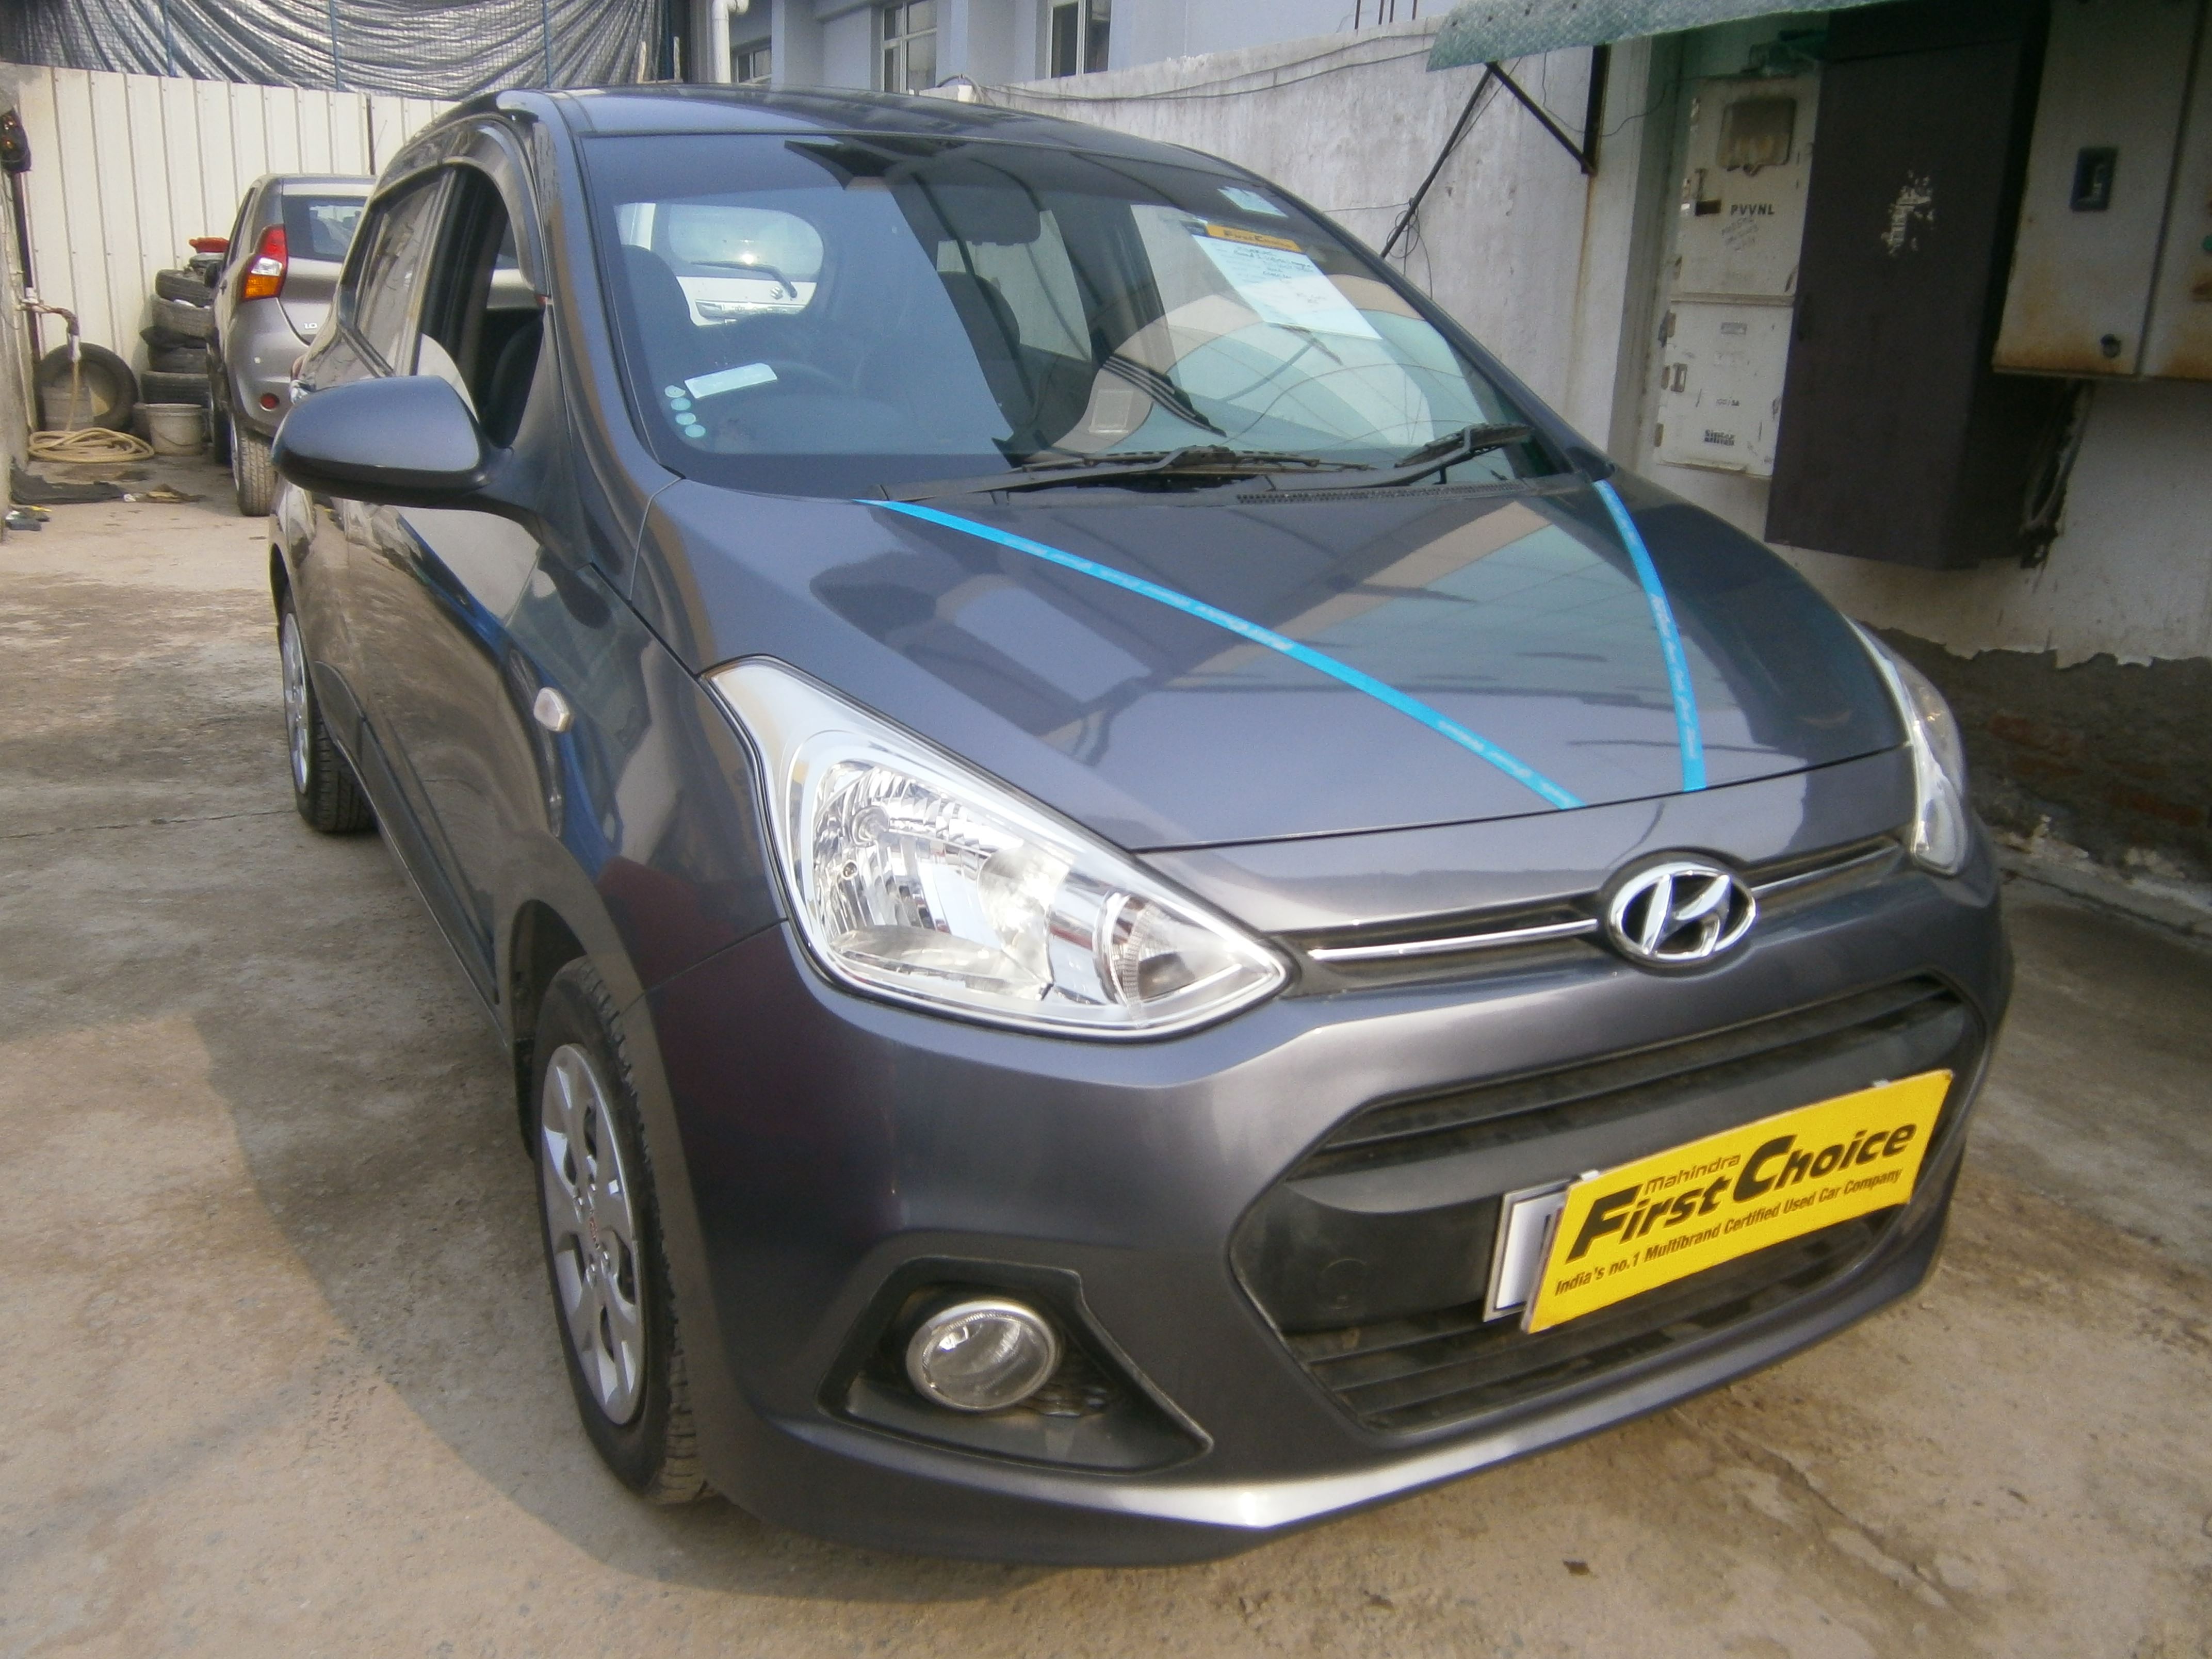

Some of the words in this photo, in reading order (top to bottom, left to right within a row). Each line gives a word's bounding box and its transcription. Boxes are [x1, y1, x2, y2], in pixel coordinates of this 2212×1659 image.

[1730, 203, 1775, 216] PVVNL
[1554, 1266, 1604, 1296] India's
[1608, 1251, 1640, 1276] no.1
[1644, 1222, 1722, 1262] Multibrand
[1724, 1202, 1781, 1234] Certified
[1783, 1191, 1816, 1214] Used
[1818, 1185, 1843, 1203] Car
[1843, 1168, 1902, 1196] Company
[1565, 1175, 1732, 1264] First
[1733, 1123, 1918, 1202] Choice
